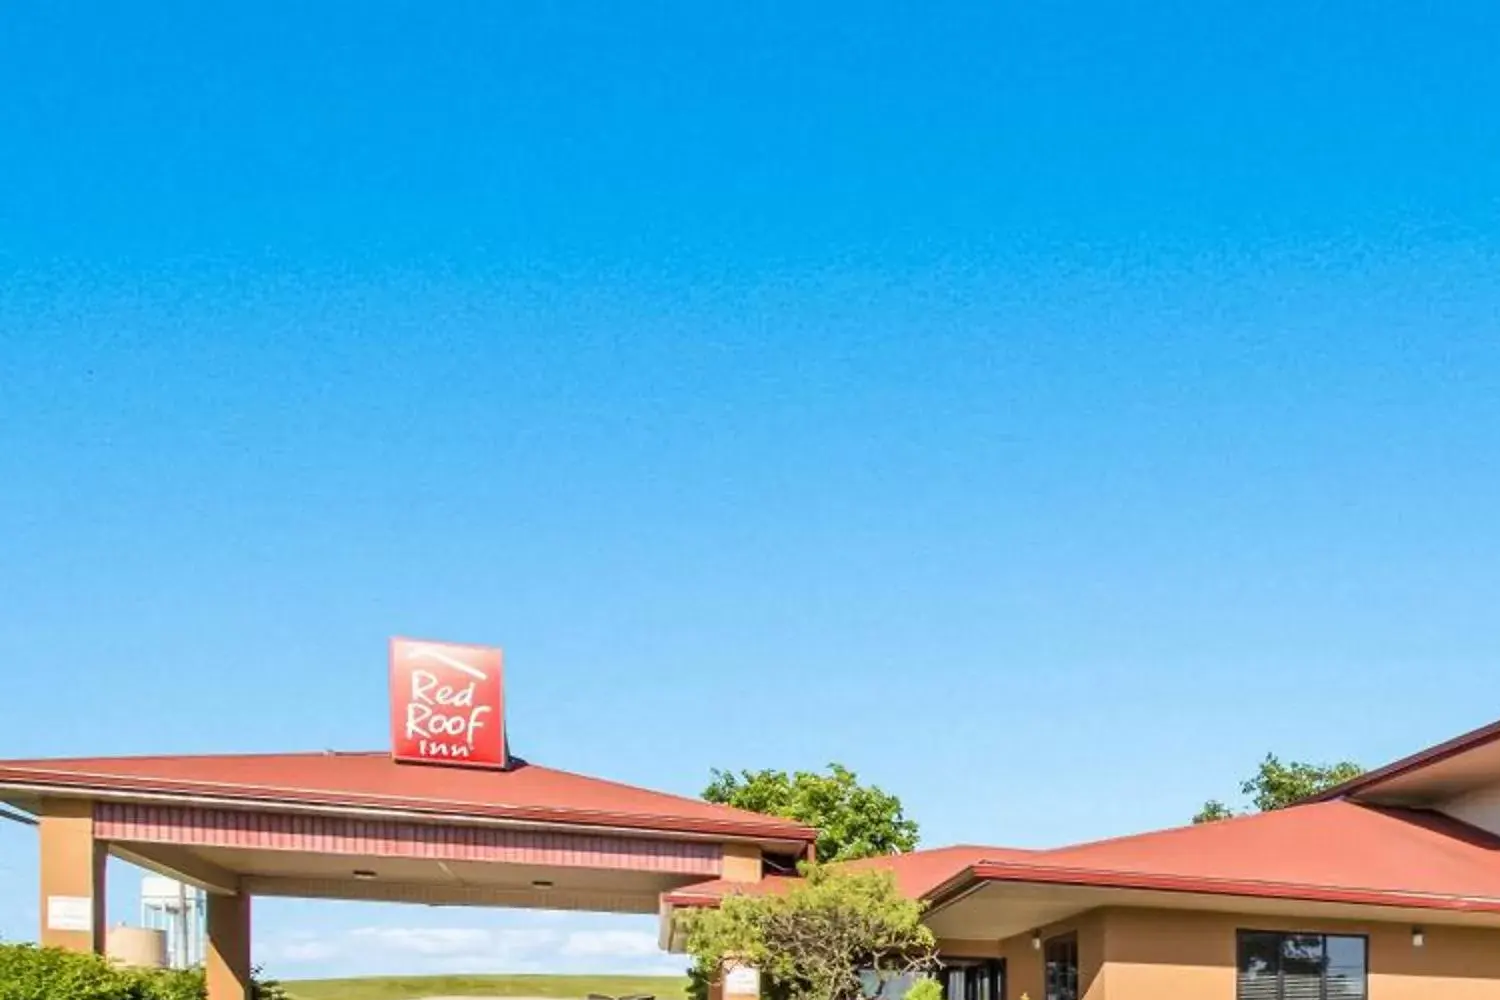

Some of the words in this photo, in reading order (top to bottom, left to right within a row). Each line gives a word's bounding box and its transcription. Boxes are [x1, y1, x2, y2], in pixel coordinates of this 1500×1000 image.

[411, 669, 476, 706] Red
[406, 702, 492, 750] Roof
[419, 739, 470, 757] Inn
